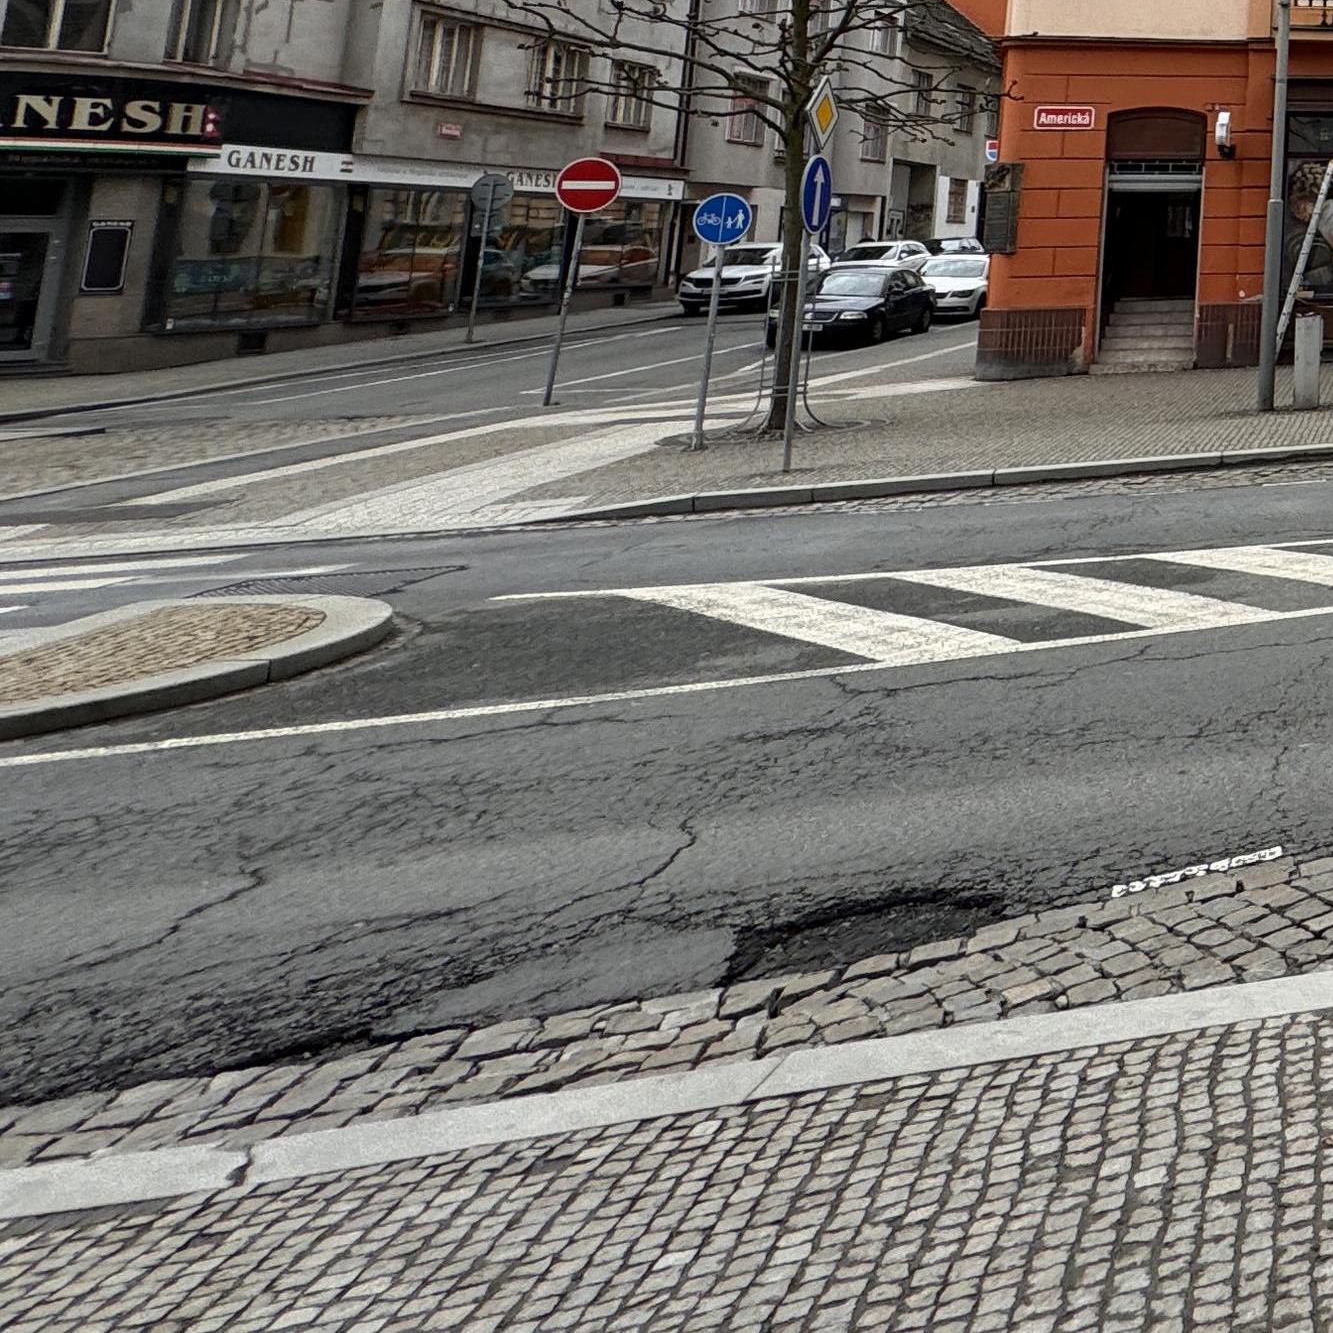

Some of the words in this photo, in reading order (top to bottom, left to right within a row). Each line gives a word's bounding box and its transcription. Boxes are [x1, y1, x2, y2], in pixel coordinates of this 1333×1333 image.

[0, 94, 207, 136] NESH
[1038, 112, 1091, 125] Americká
[227, 148, 316, 174] GANESH
[506, 170, 560, 188] GANES
